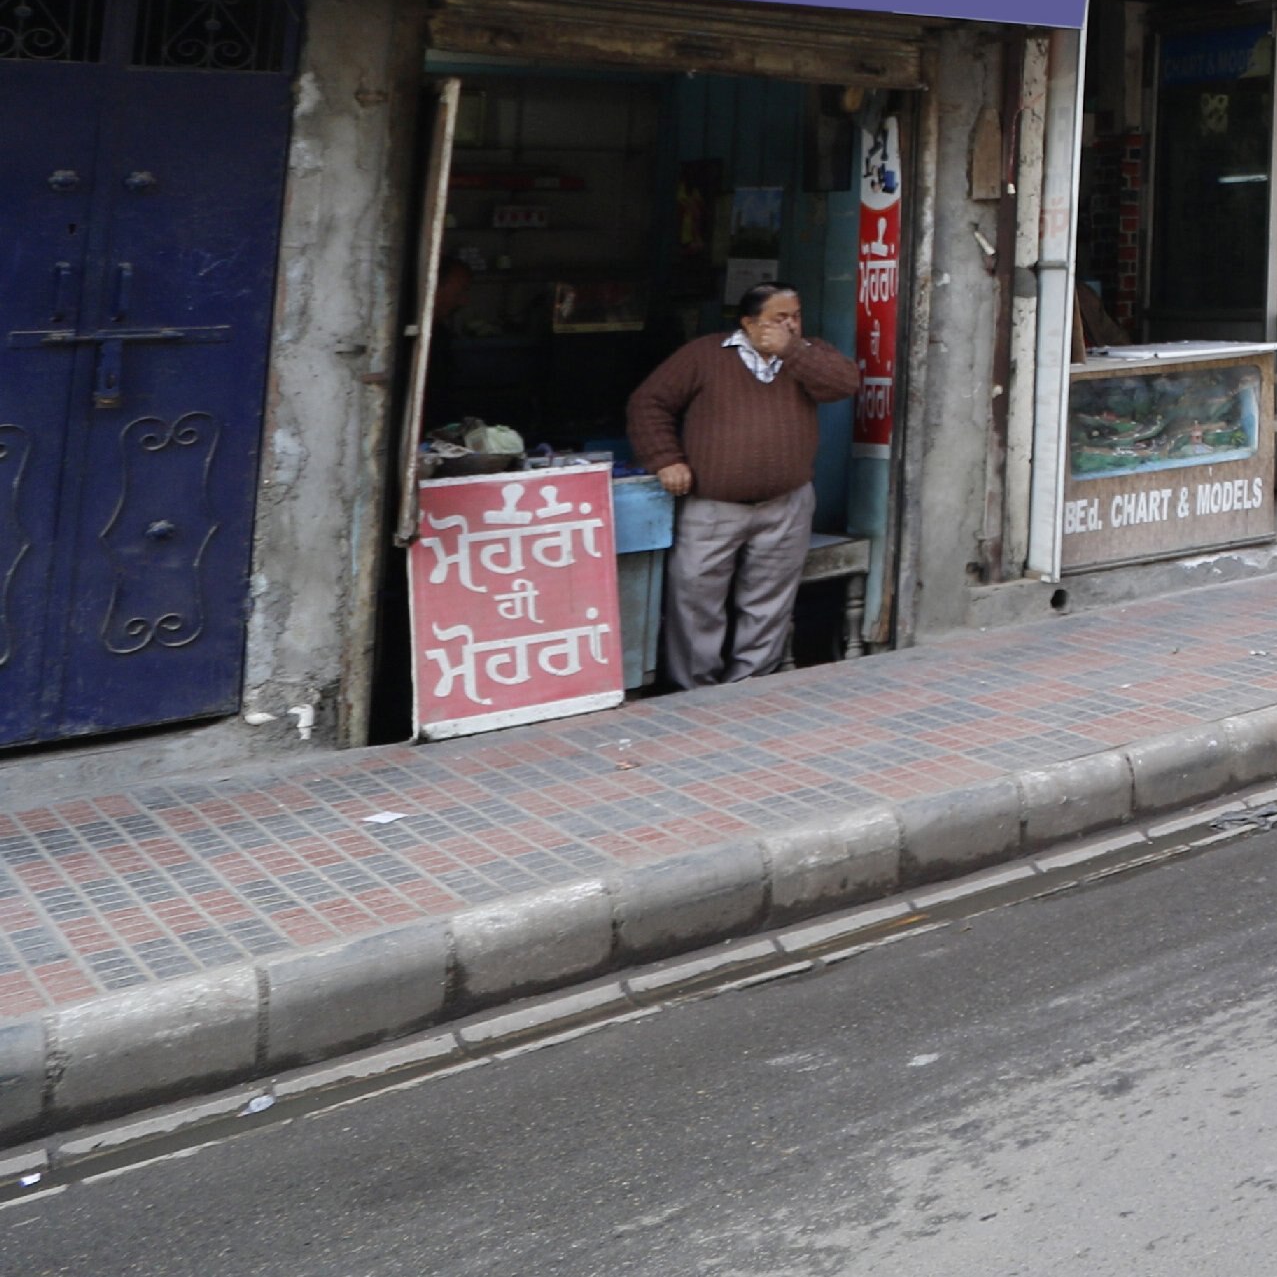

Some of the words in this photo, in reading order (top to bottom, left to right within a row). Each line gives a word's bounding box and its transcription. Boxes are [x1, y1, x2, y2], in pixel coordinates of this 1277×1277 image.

[1110, 488, 1173, 528] CHART
[1177, 486, 1191, 518] &
[1196, 477, 1264, 516] MODELS
